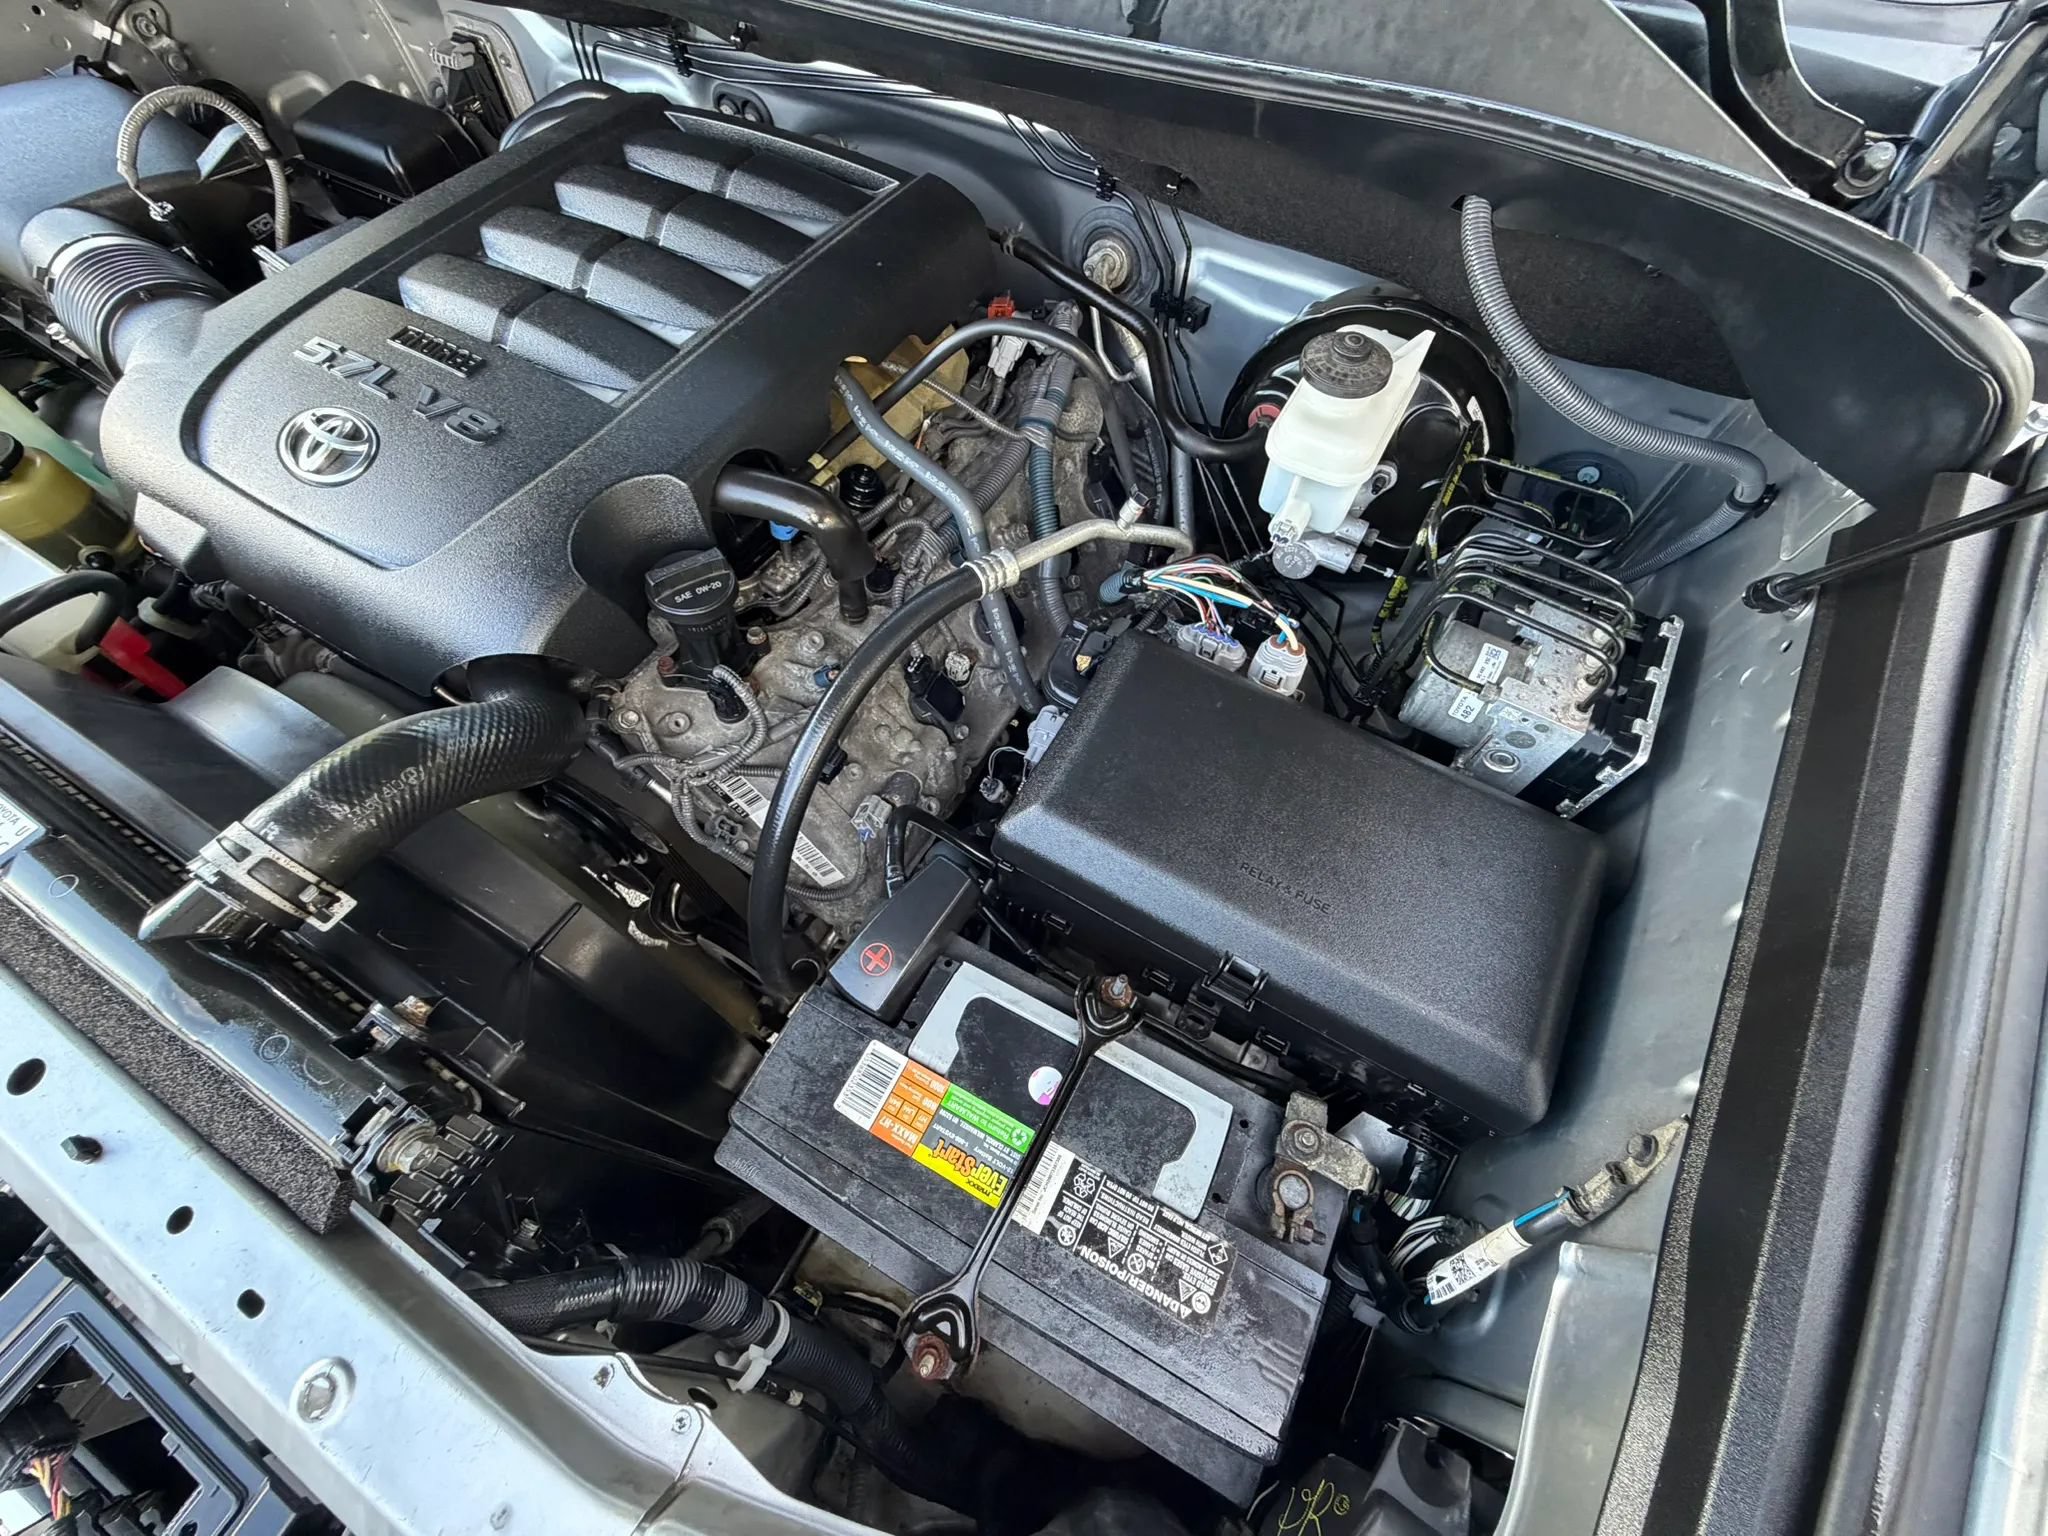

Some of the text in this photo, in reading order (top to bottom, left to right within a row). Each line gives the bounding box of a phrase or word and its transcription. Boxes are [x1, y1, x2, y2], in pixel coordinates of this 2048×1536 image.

[293, 336, 502, 445] 5.7L V8
[674, 581, 722, 603] SAE 0W-20
[1452, 696, 1468, 715] TOYOTA
[1461, 705, 1475, 720] 482
[1240, 862, 1332, 915] RELAY & FUSE
[946, 1099, 980, 1122] WALMART
[878, 1114, 918, 1143] MAXX-H7
[986, 1122, 1008, 1139] Return
[928, 1136, 1010, 1197] EverStart
[1098, 1191, 1150, 1224] READ INSTRUCTIONS.
[1079, 1244, 1180, 1312] DANGER/POISON
